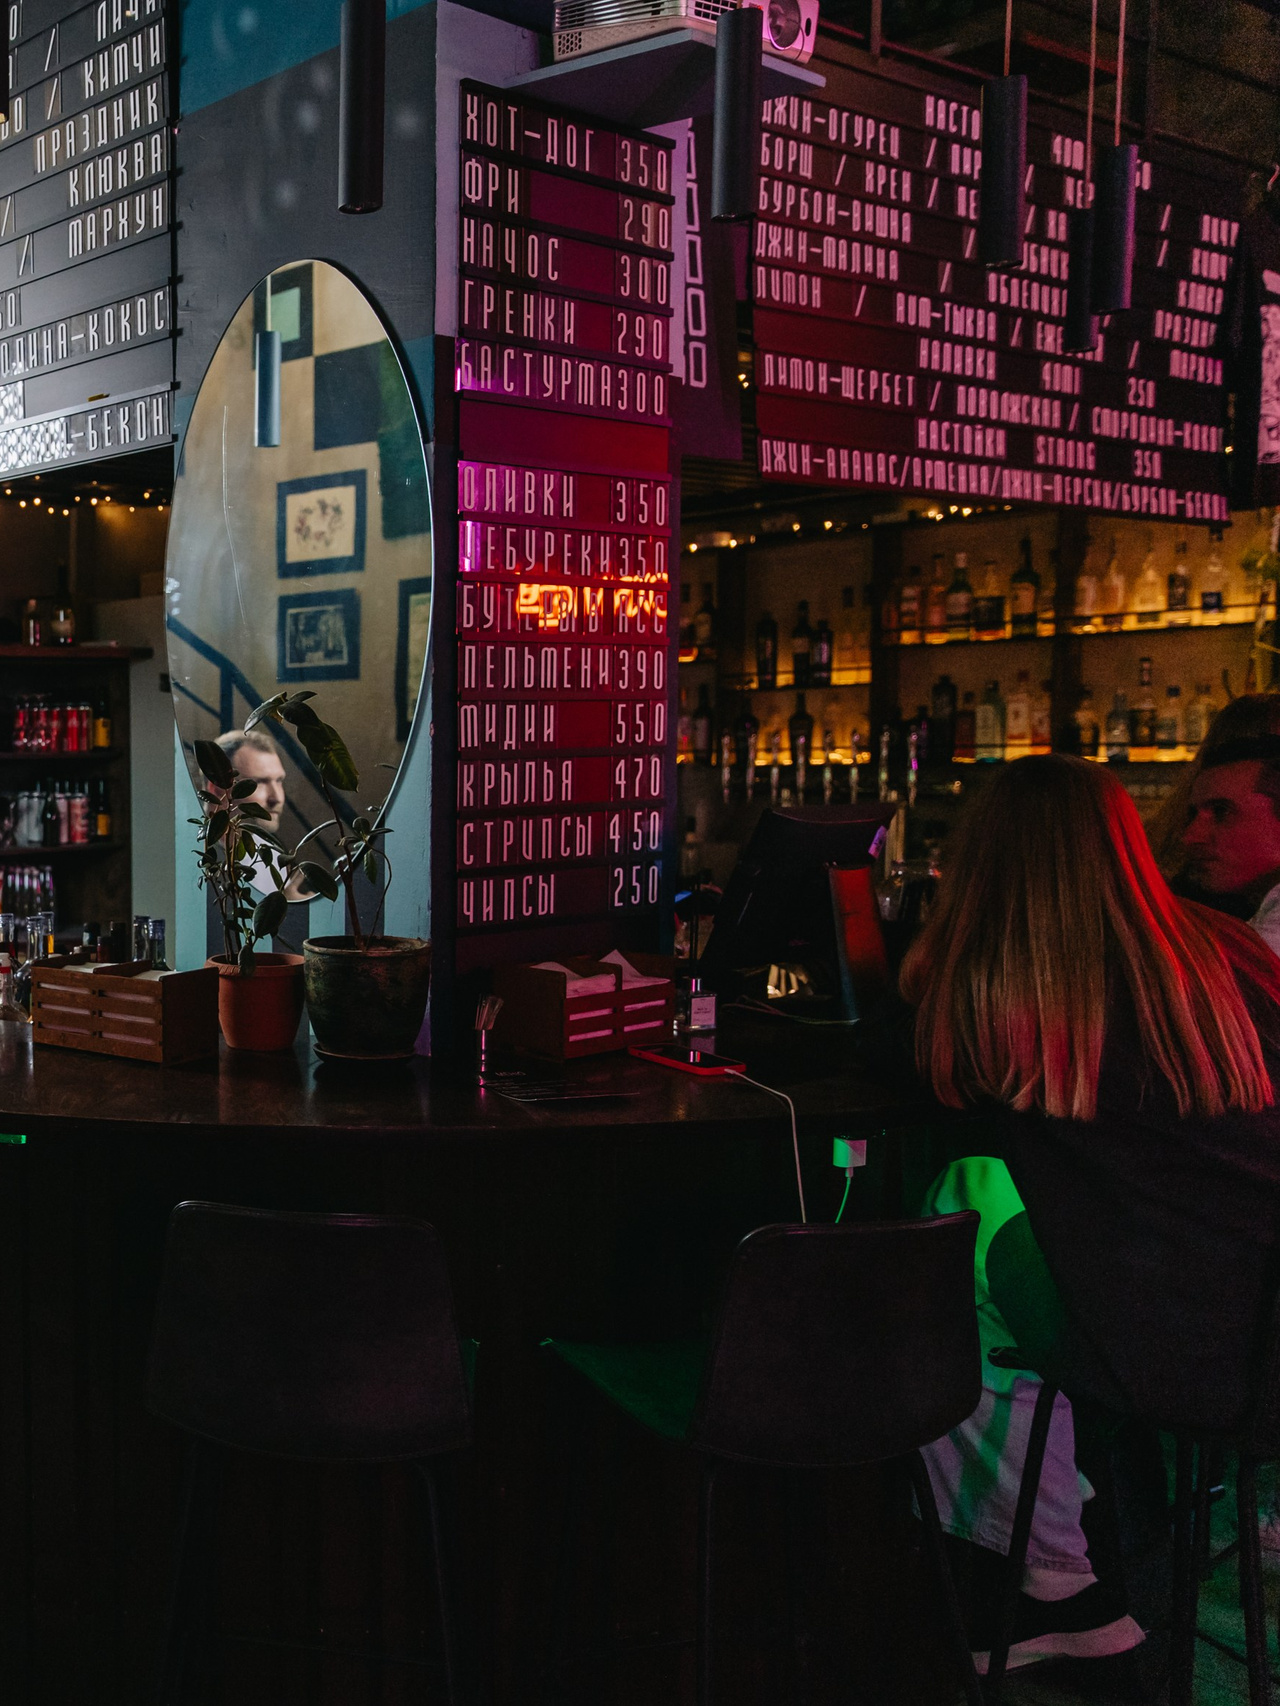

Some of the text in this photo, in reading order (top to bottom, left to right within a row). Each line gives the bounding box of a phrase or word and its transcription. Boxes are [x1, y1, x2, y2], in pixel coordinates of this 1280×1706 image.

[84, 24, 160, 98] КИМЧИ
[37, 82, 158, 173] ПРАЗДНИК
[466, 94, 666, 191] ХОТ-ДОГ 350
[926, 95, 980, 141] НАСТО
[70, 134, 162, 207] КЛЮКВА
[761, 132, 812, 180] БОРЩ
[865, 161, 911, 202] ХРЕН
[465, 157, 668, 249] ФРИ 290
[759, 177, 911, 243] БУРБОН-ВИШНЯ
[463, 217, 666, 305] НАЧОС 300
[756, 222, 898, 281] ДЖИН-МАЛИНА
[464, 280, 662, 359] ГРЕНКИ 290
[461, 342, 663, 416] БАСТУРМА 300
[764, 354, 915, 407] ЛИМОН-ЩЕРБЕТ
[464, 466, 665, 526] ОЛИВКИ 350
[464, 645, 663, 690] ПЕЛЬМЕНИ 390
[460, 702, 664, 750] МИДИИ 550
[463, 757, 661, 807] КРЫЛЬЯ 470
[610, 811, 659, 853] 450
[463, 865, 658, 924] ЧИПСЫ 250
